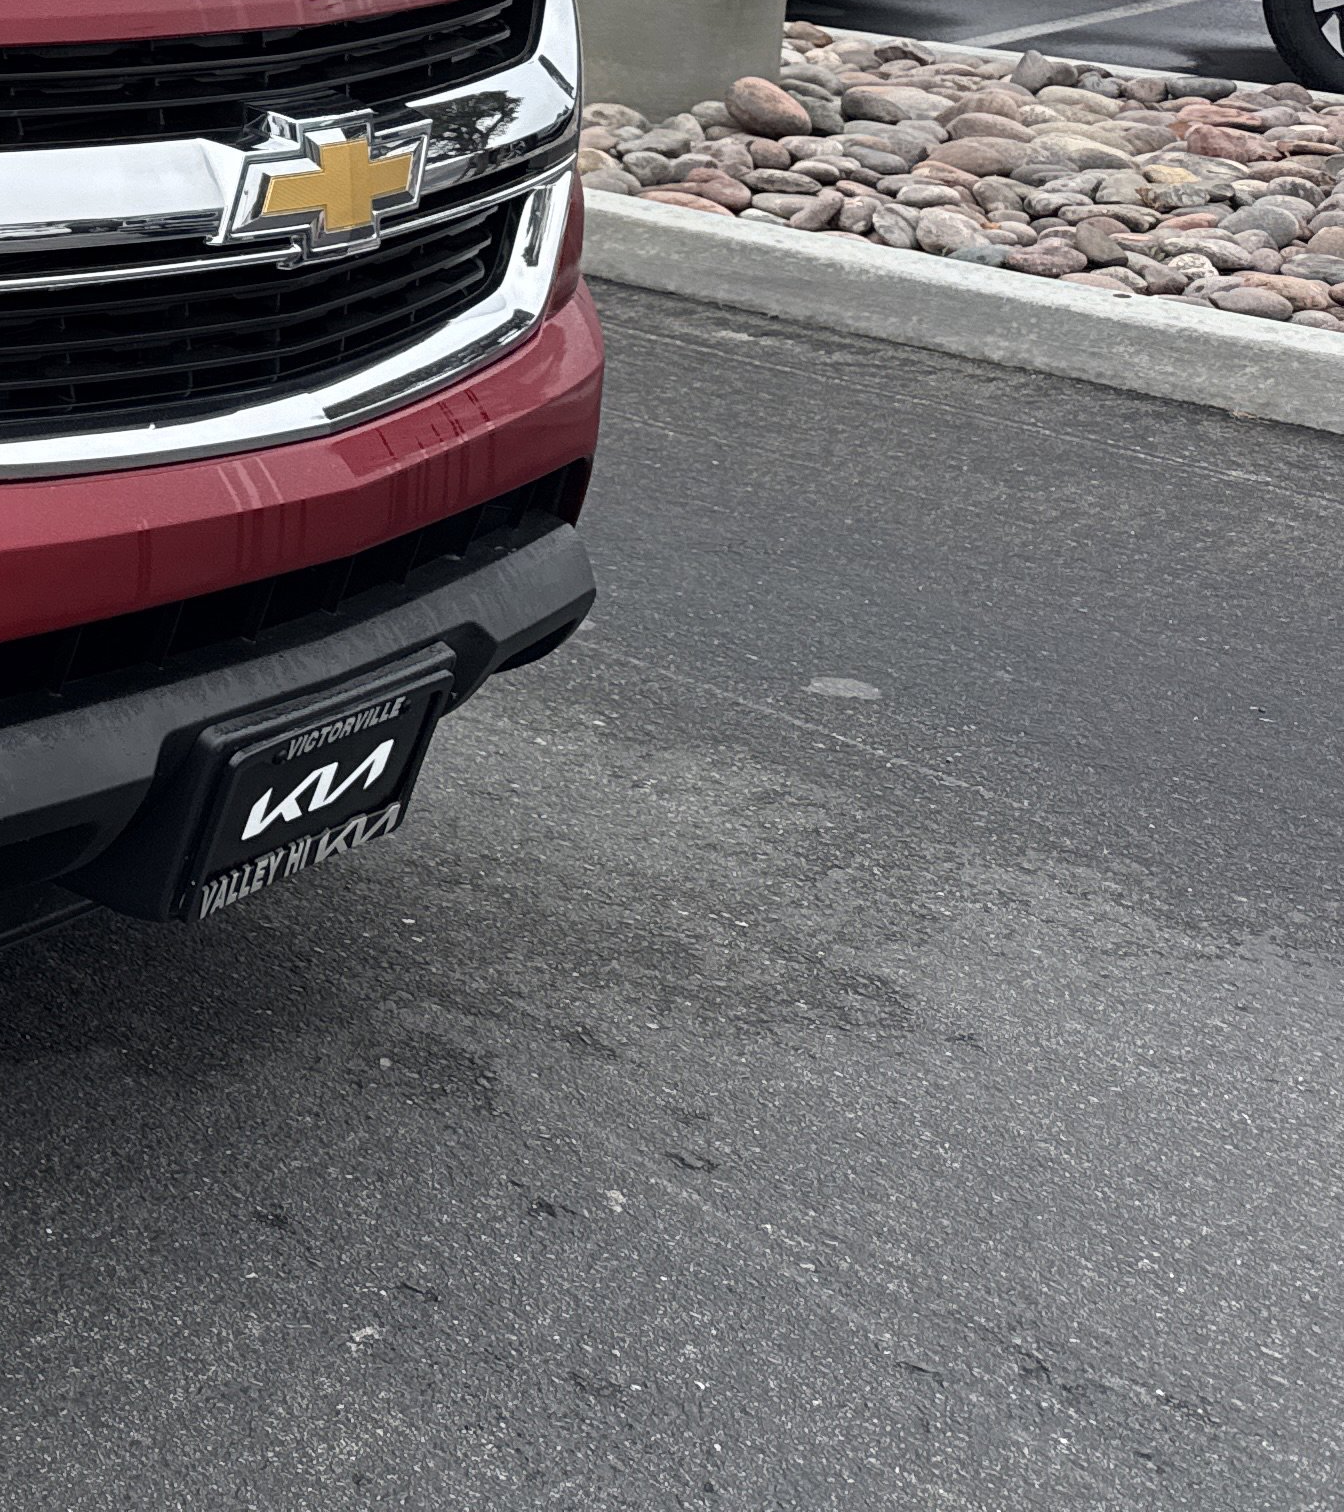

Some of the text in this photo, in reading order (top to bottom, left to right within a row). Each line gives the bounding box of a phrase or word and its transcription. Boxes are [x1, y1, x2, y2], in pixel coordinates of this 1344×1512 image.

[286, 695, 407, 761] VICTORVILLE
[241, 738, 395, 841] KIA
[199, 801, 401, 920] VALLEY HI KIA
